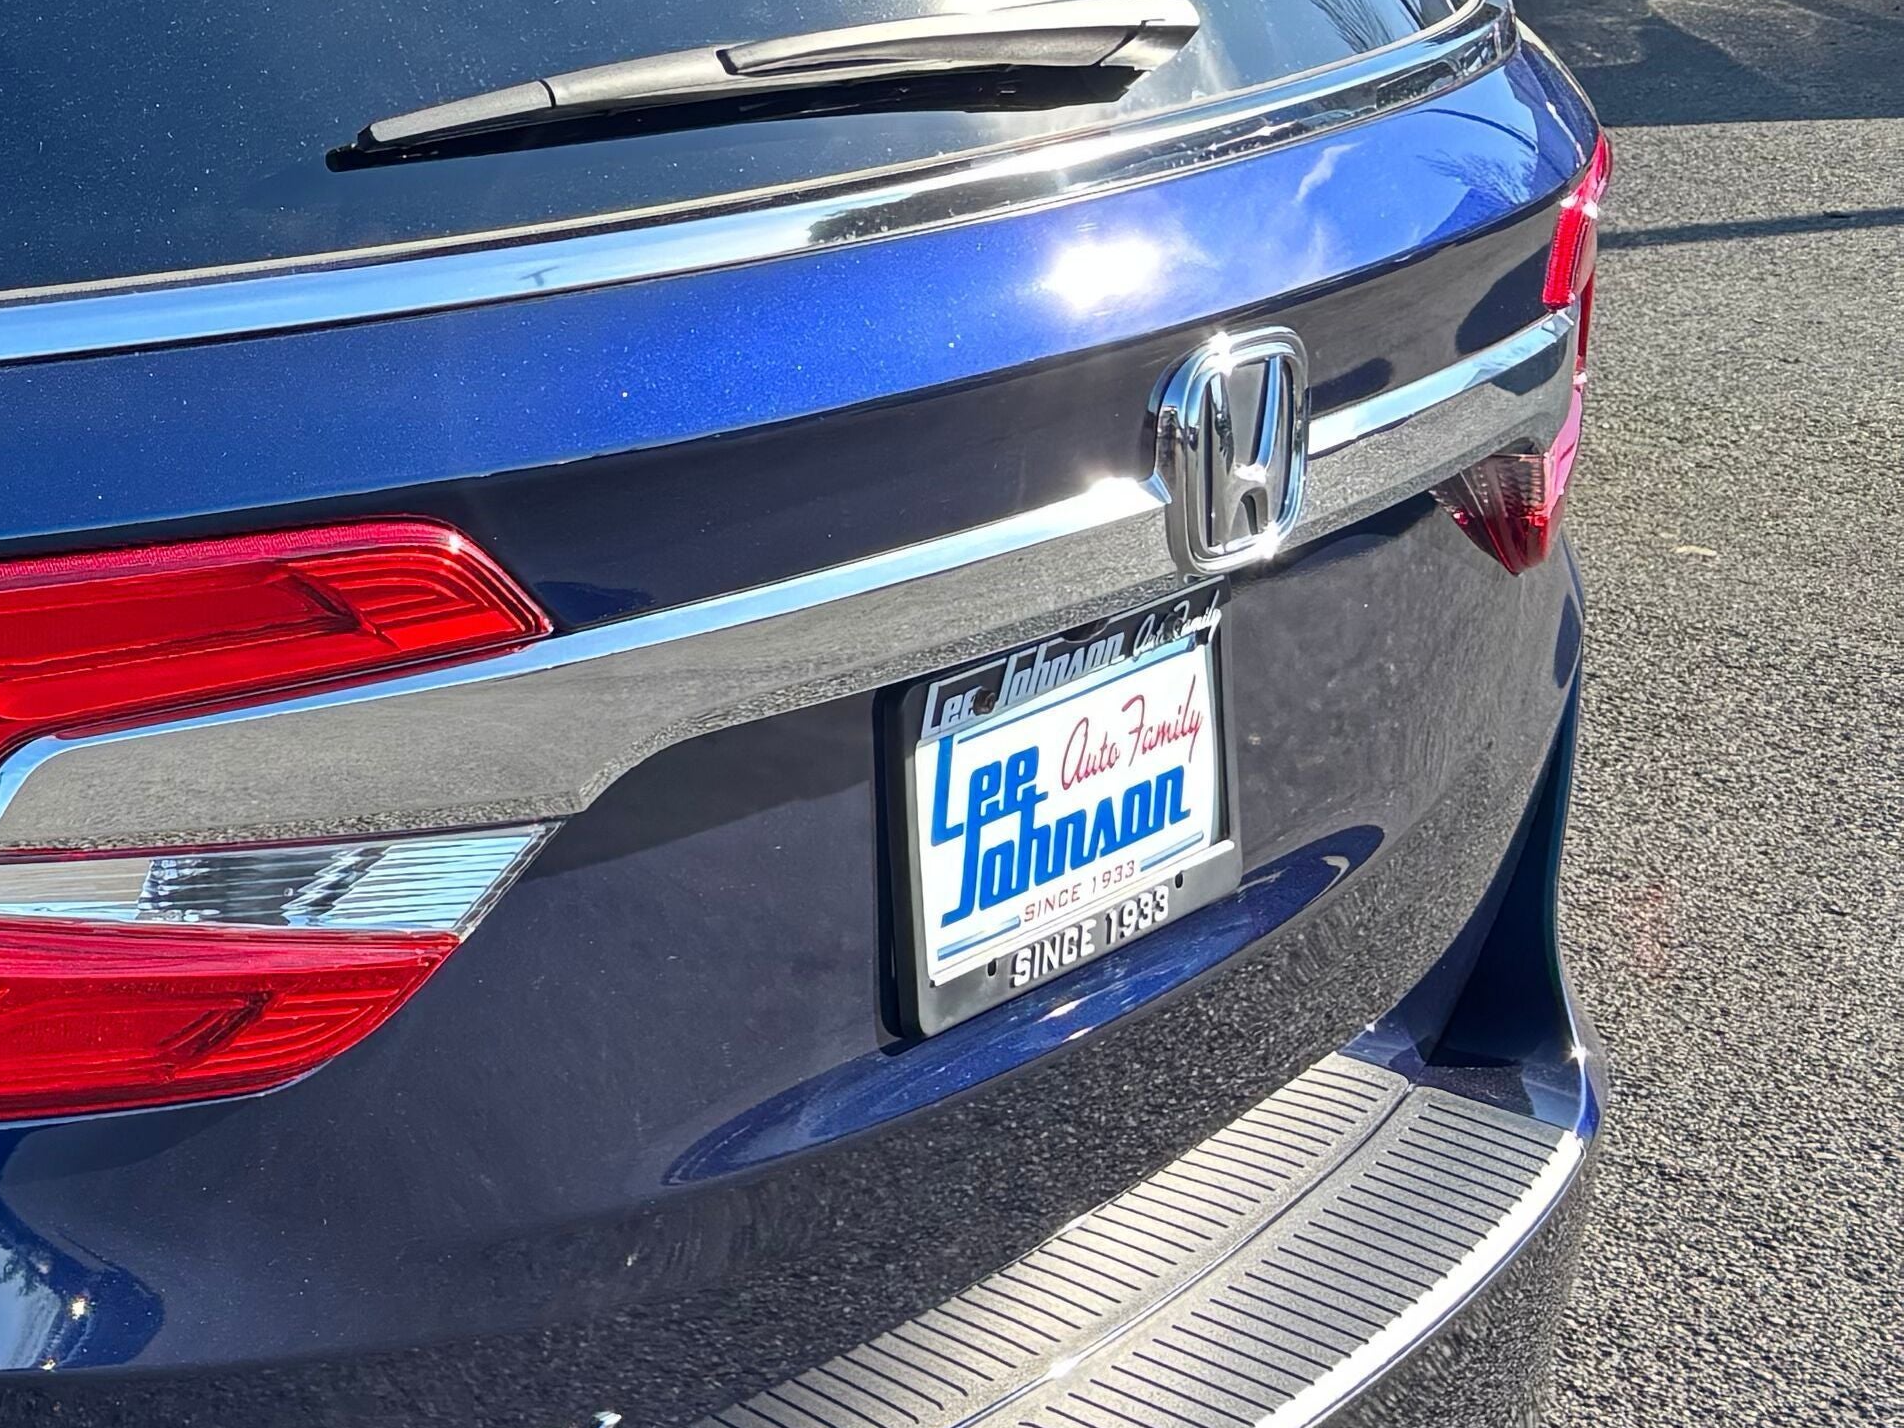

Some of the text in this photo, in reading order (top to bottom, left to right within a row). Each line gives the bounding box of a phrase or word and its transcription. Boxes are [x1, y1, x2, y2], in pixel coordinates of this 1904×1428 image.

[994, 632, 1126, 712] Johnson
[1061, 674, 1204, 792] Auto Family
[931, 735, 1048, 848] Lee
[941, 766, 1192, 929] Johnson
[1023, 858, 1137, 924] SINCE 1933
[1010, 883, 1170, 988] SINCE 1933
